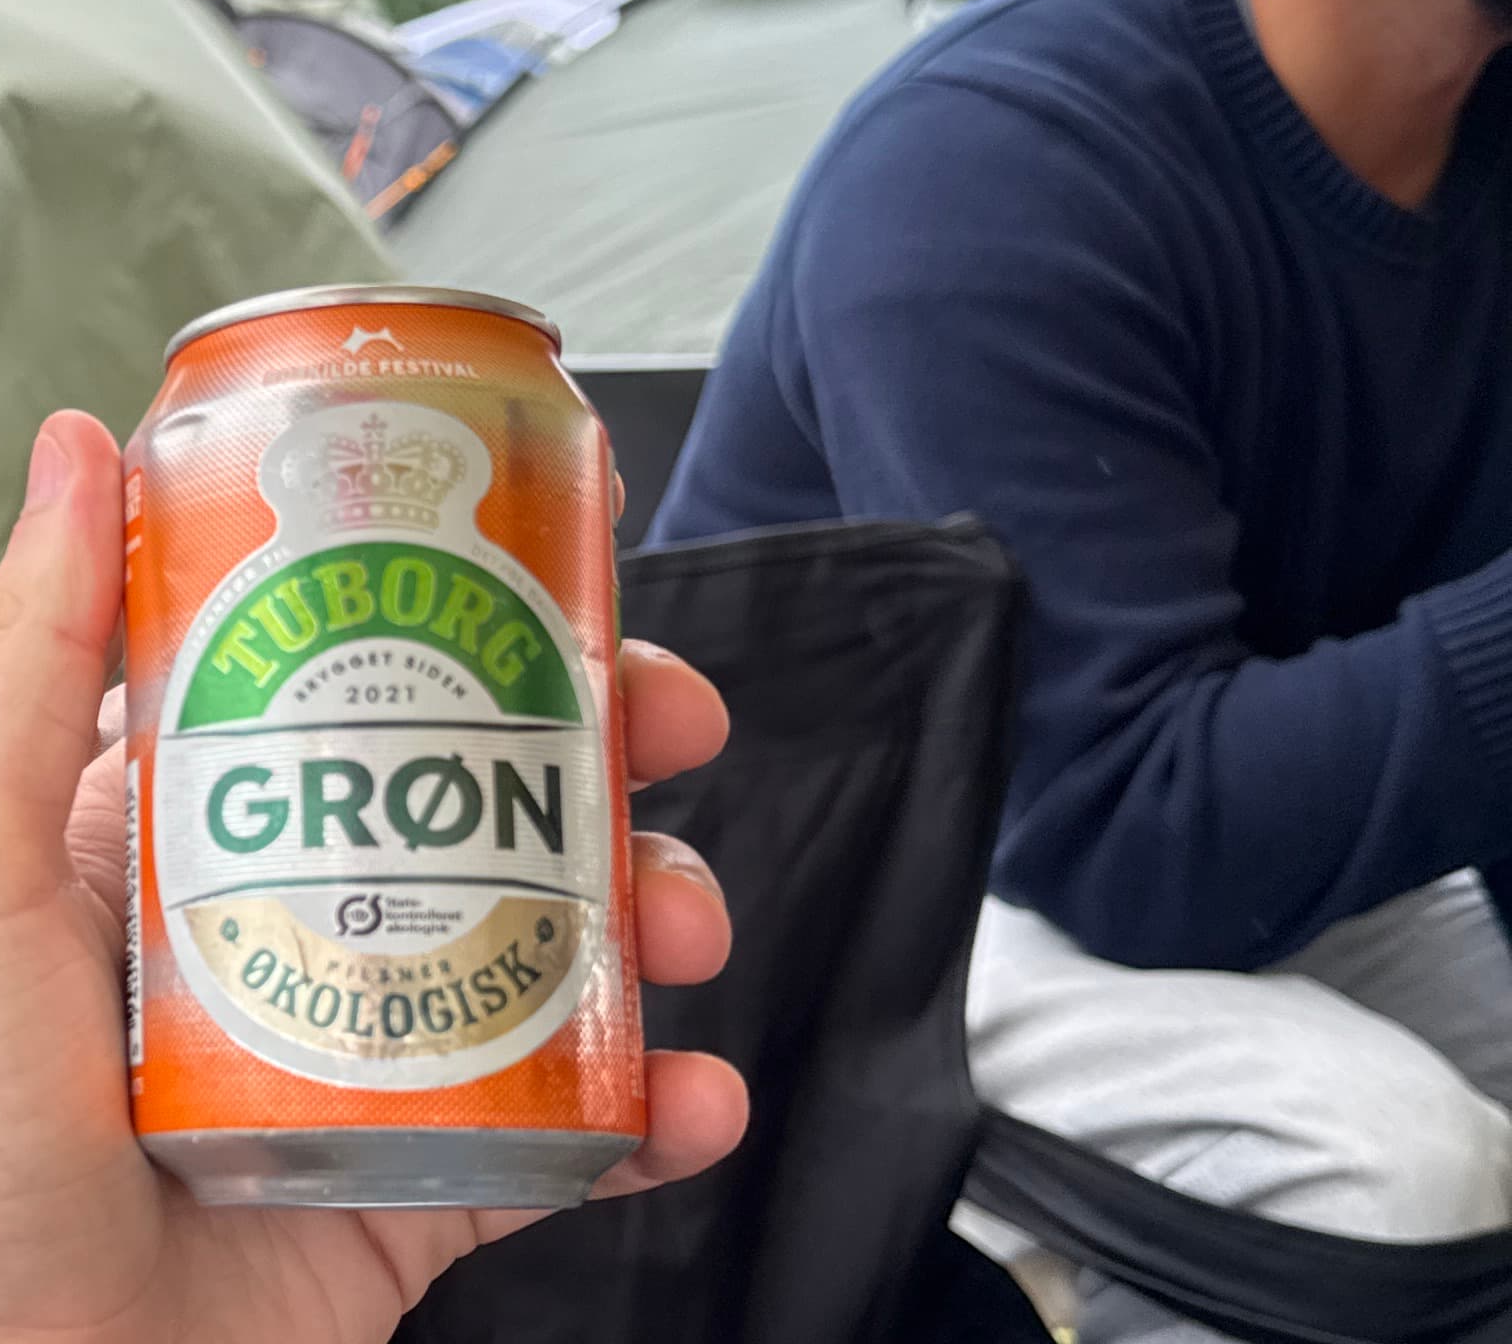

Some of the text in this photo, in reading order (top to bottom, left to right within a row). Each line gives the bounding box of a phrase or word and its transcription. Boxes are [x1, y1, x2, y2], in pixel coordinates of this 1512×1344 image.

[380, 359, 481, 380] FESTIVAL
[211, 556, 543, 689] TUBORG
[294, 651, 469, 702] BRYGGET SIDEN
[345, 685, 417, 704] 2021
[205, 753, 566, 856] GRØN
[241, 939, 544, 1039] ØKOLOGISK
[326, 959, 452, 984] PILSNER
